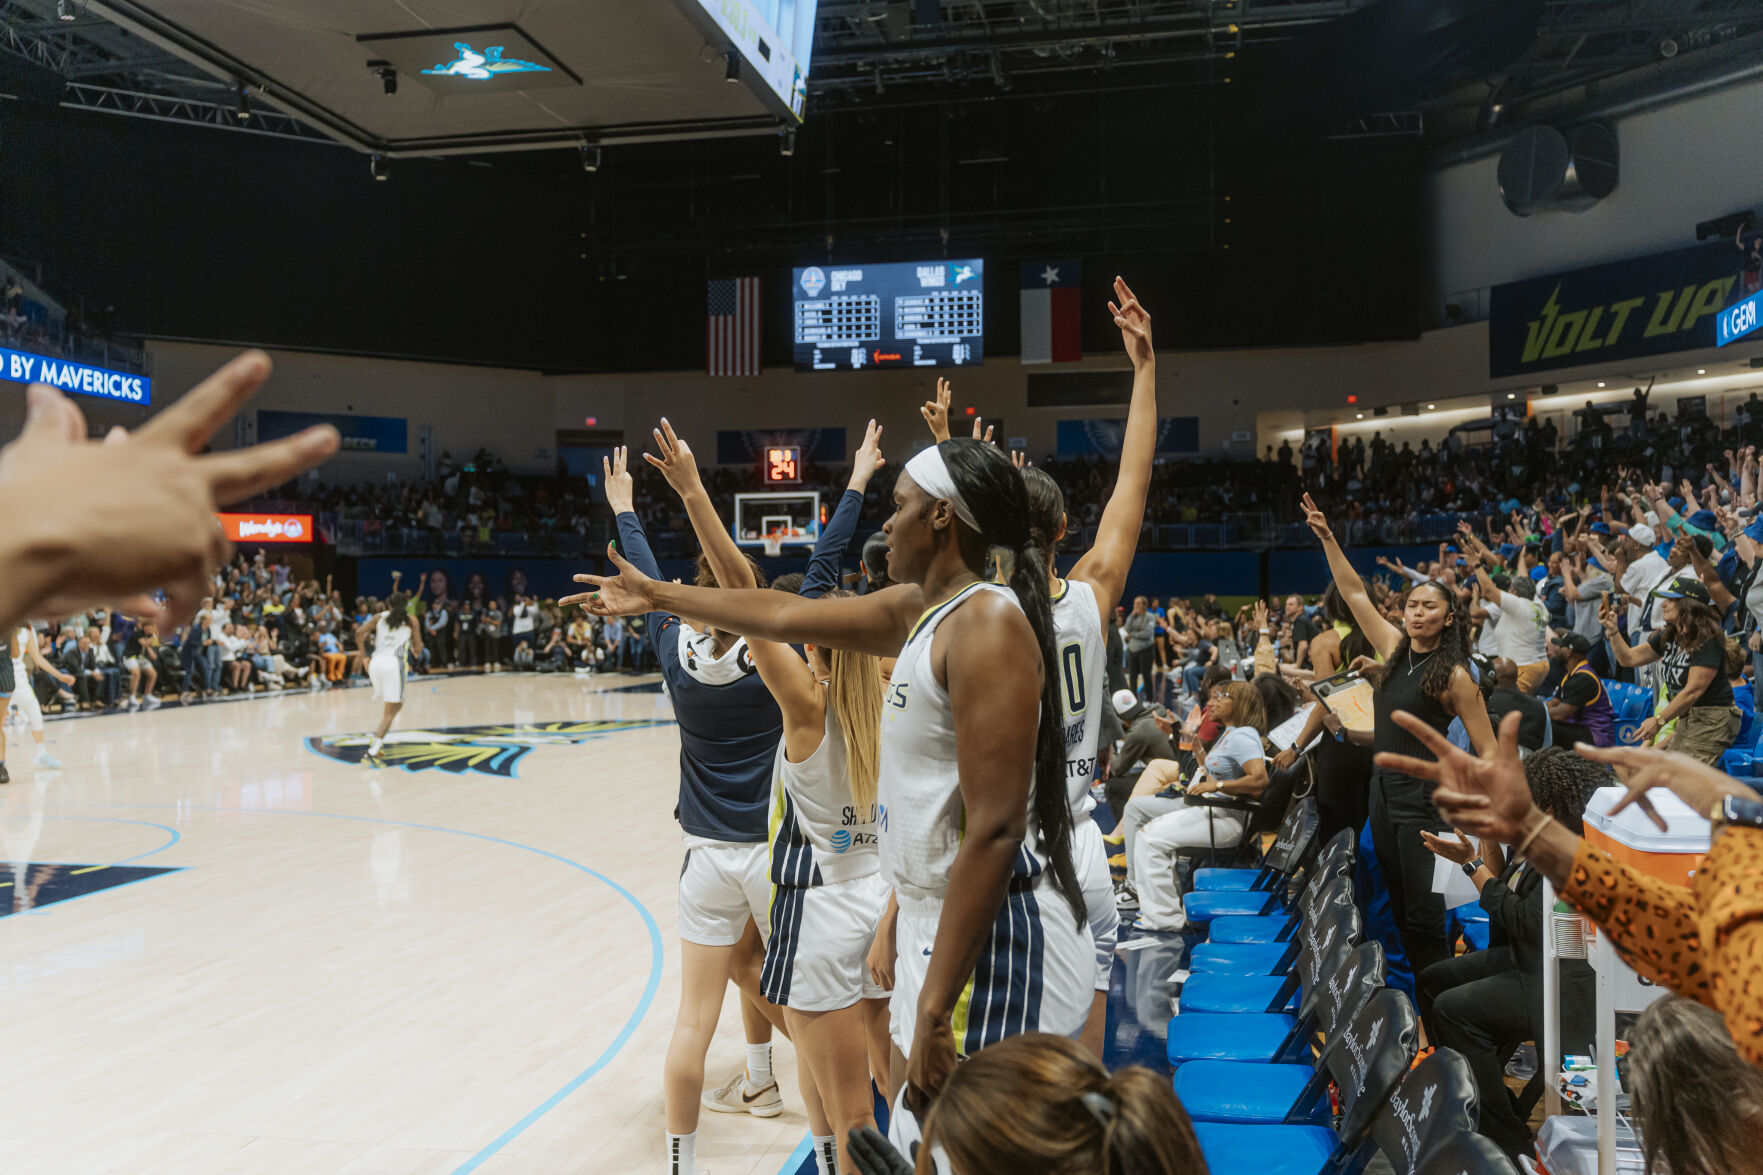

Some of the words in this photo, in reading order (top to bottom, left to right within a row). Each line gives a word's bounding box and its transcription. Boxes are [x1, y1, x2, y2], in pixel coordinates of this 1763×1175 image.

[1520, 281, 1645, 363] VOLT
[1643, 275, 1738, 338] UP
[10, 353, 35, 381] BY
[39, 359, 144, 402] MAVERICKS
[771, 461, 795, 480] 24
[1062, 718, 1086, 748] ARES
[1065, 757, 1096, 778] T&T
